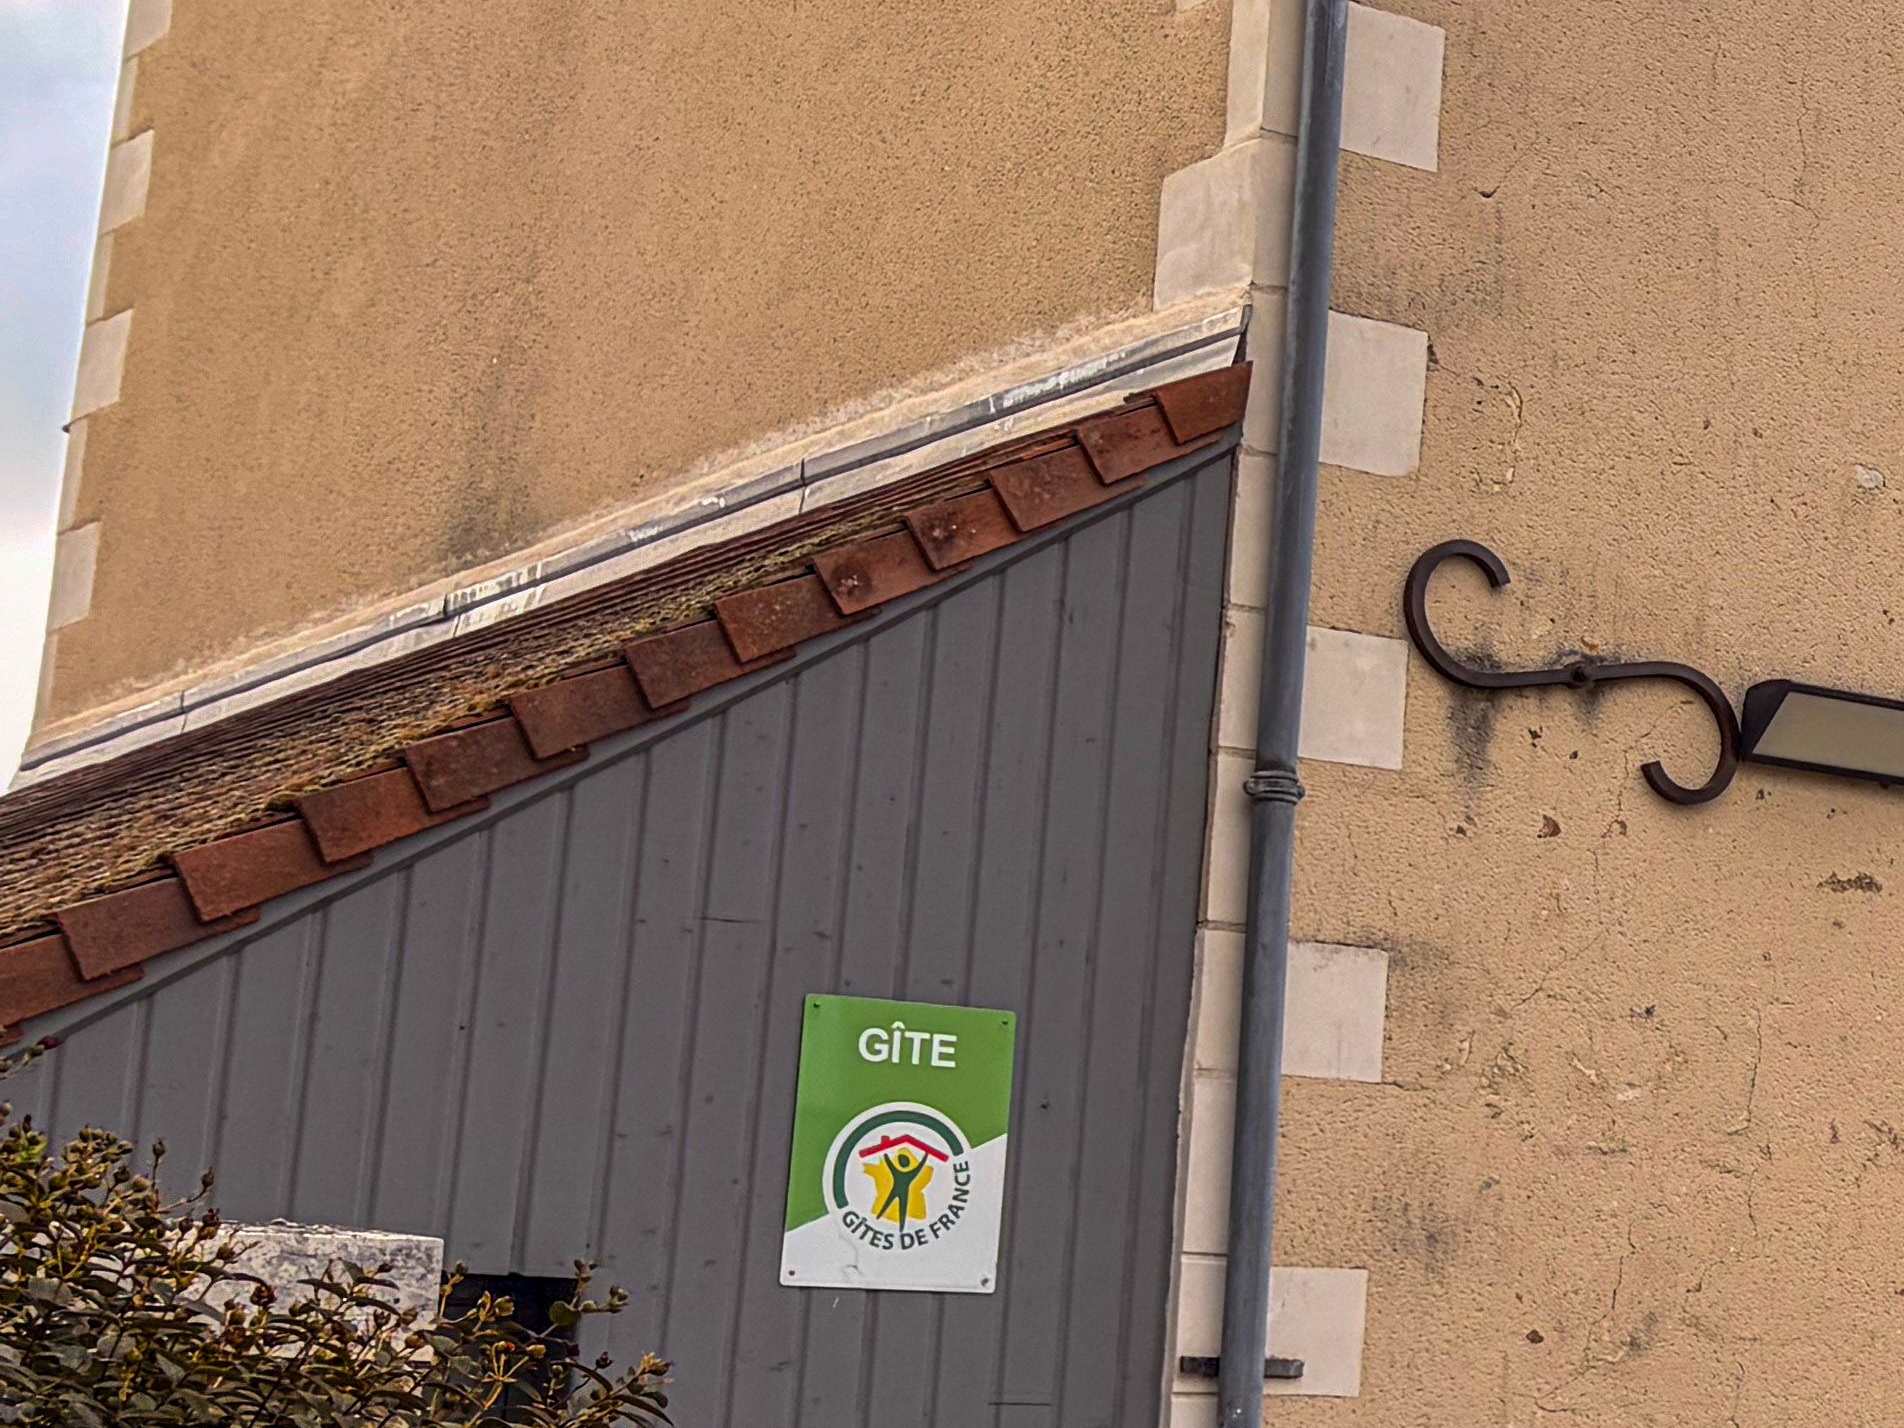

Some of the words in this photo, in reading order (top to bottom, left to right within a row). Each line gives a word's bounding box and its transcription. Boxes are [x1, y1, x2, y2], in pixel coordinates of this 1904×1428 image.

[858, 1021, 957, 1068] GÎTE
[842, 1210, 894, 1250] GÎTES
[900, 1231, 929, 1250] DE
[932, 1160, 970, 1240] FRANCE
